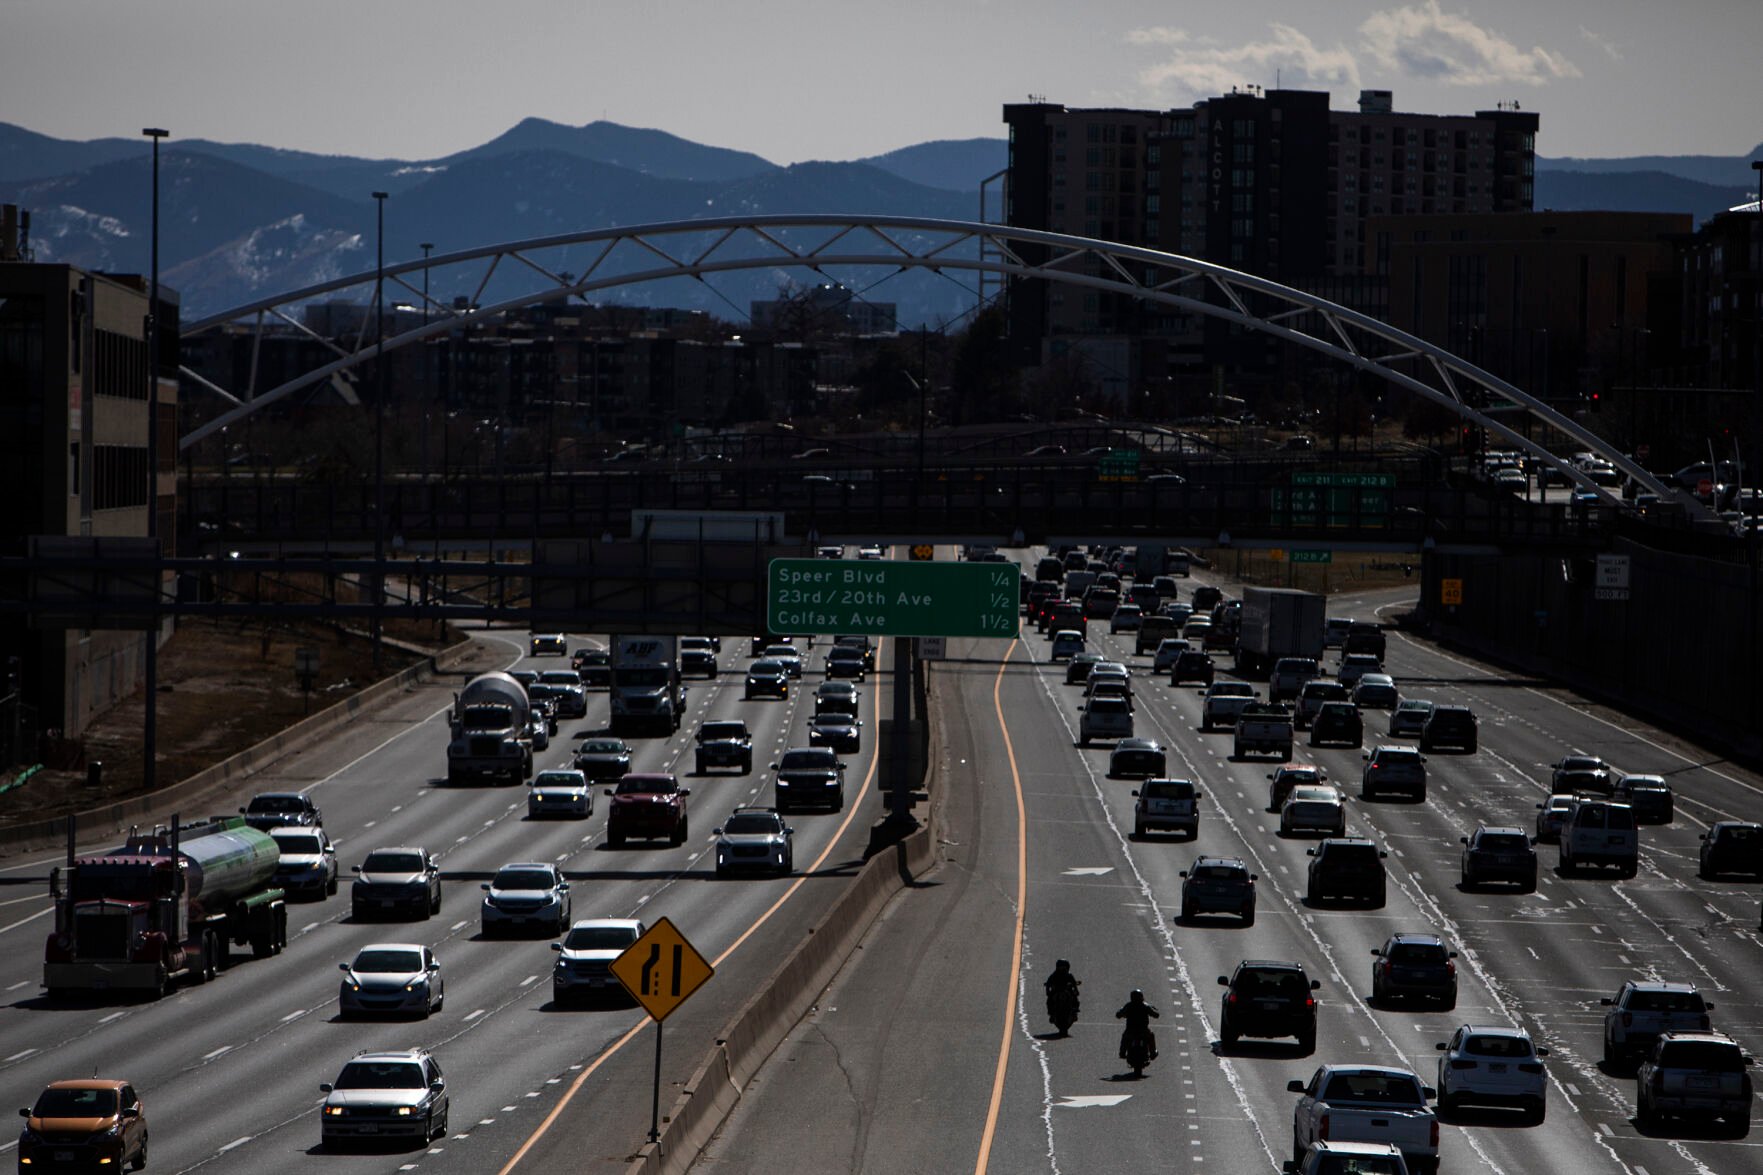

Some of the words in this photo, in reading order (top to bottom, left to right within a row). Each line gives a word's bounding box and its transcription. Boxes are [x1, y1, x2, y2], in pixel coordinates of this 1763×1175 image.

[1212, 119, 1223, 213] ALCOTT
[779, 568, 832, 584] Speer
[843, 569, 885, 584] Blvd
[897, 592, 932, 605] Ave
[778, 611, 838, 625] Colfax
[850, 612, 886, 626] Ave
